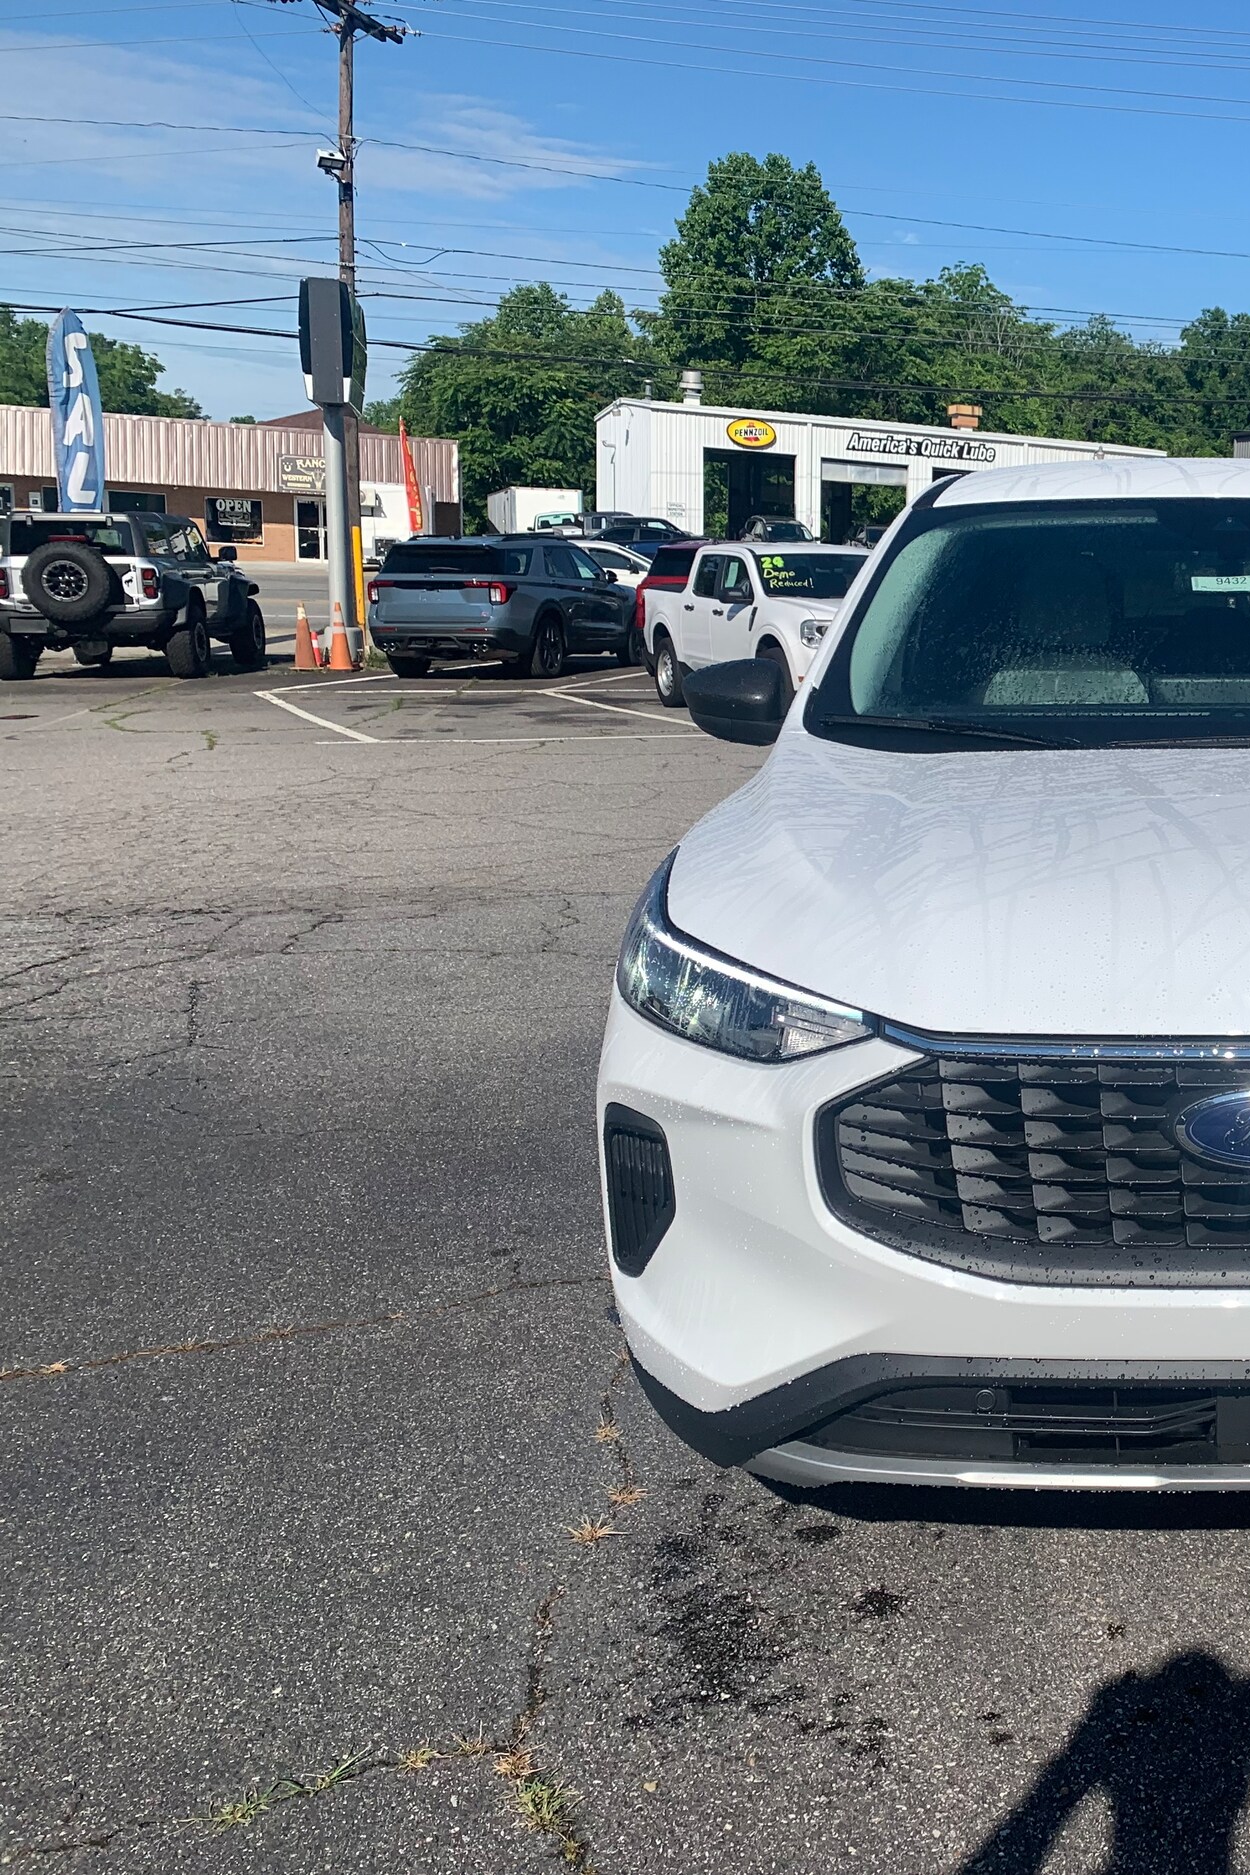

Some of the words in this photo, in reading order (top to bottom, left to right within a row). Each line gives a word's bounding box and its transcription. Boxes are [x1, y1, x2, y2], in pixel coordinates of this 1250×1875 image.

[63, 332, 101, 512] SAL
[734, 428, 768, 437] PENNZOIL
[847, 432, 918, 456] America's
[920, 438, 960, 458] Quick
[961, 442, 996, 462] Lube
[296, 459, 326, 469] RANC
[216, 499, 251, 513] OPEN
[761, 556, 785, 568] 24
[763, 568, 796, 579] Demo
[769, 577, 815, 589] Reduced!
[1215, 576, 1248, 585] 9432
